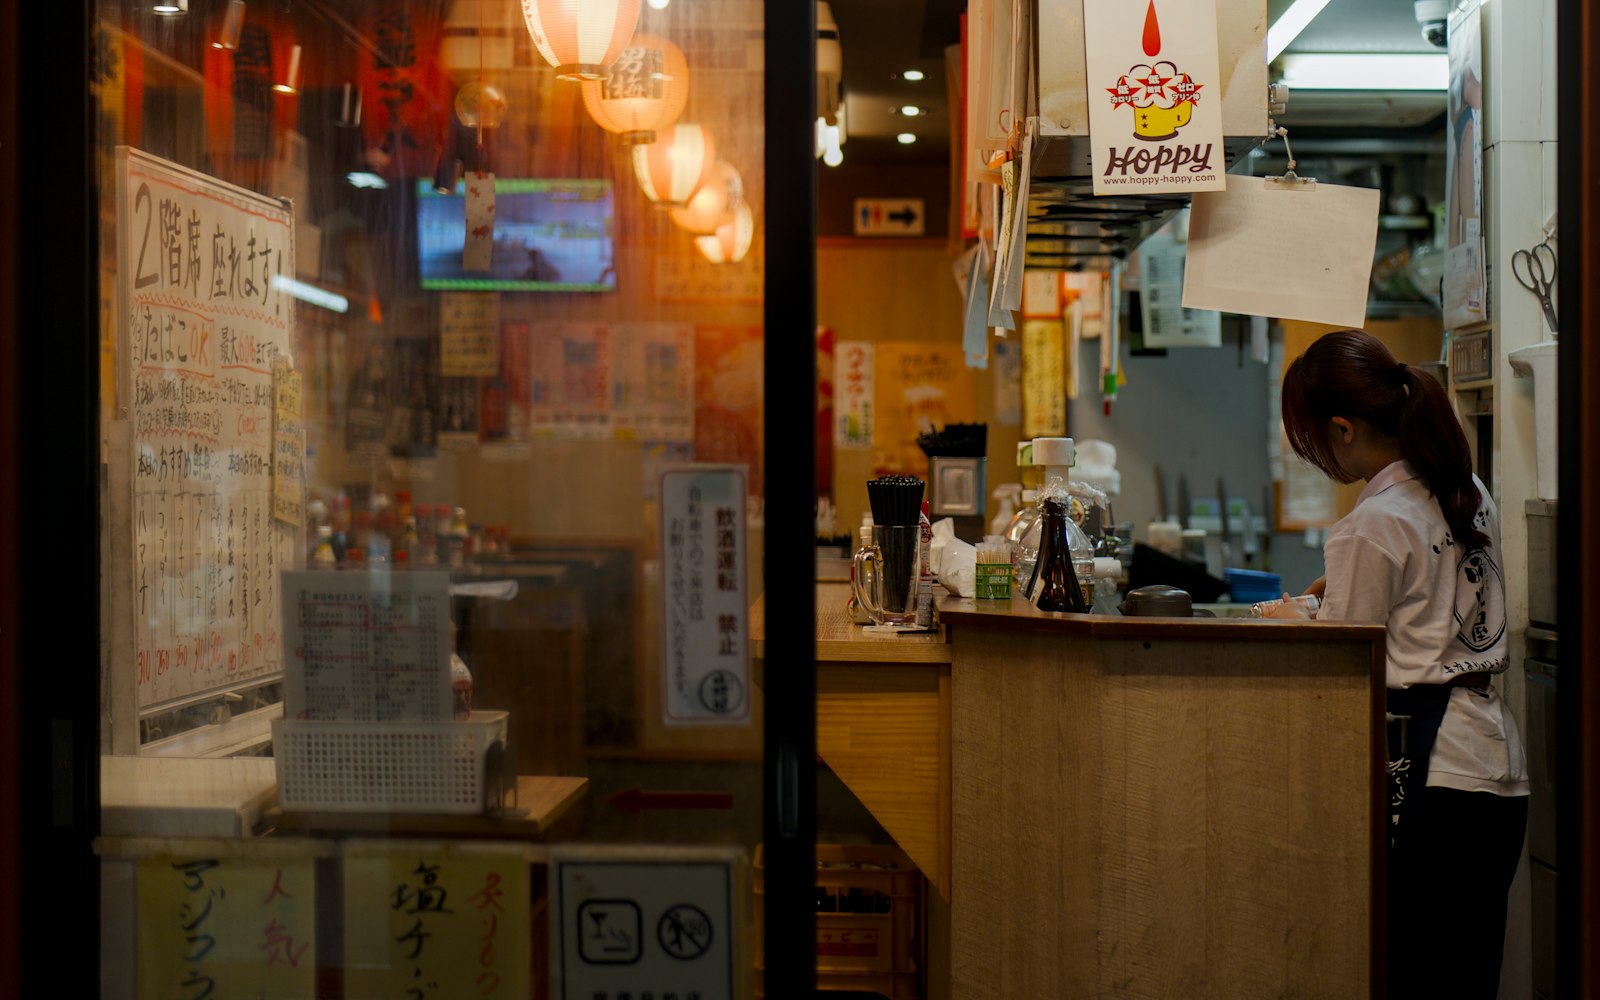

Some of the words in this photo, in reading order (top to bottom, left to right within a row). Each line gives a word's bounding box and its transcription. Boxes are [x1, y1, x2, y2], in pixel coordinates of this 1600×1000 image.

[1110, 96, 1139, 104] カロリー
[1176, 83, 1195, 92] ゼロ
[1103, 143, 1213, 176] Hoppy
[1103, 175, 1216, 185] www.hoppy-happy.com
[134, 182, 202, 298] 2階席
[716, 507, 738, 592] 飲酒運転
[718, 614, 739, 656] 禁止
[258, 867, 309, 968] 人気
